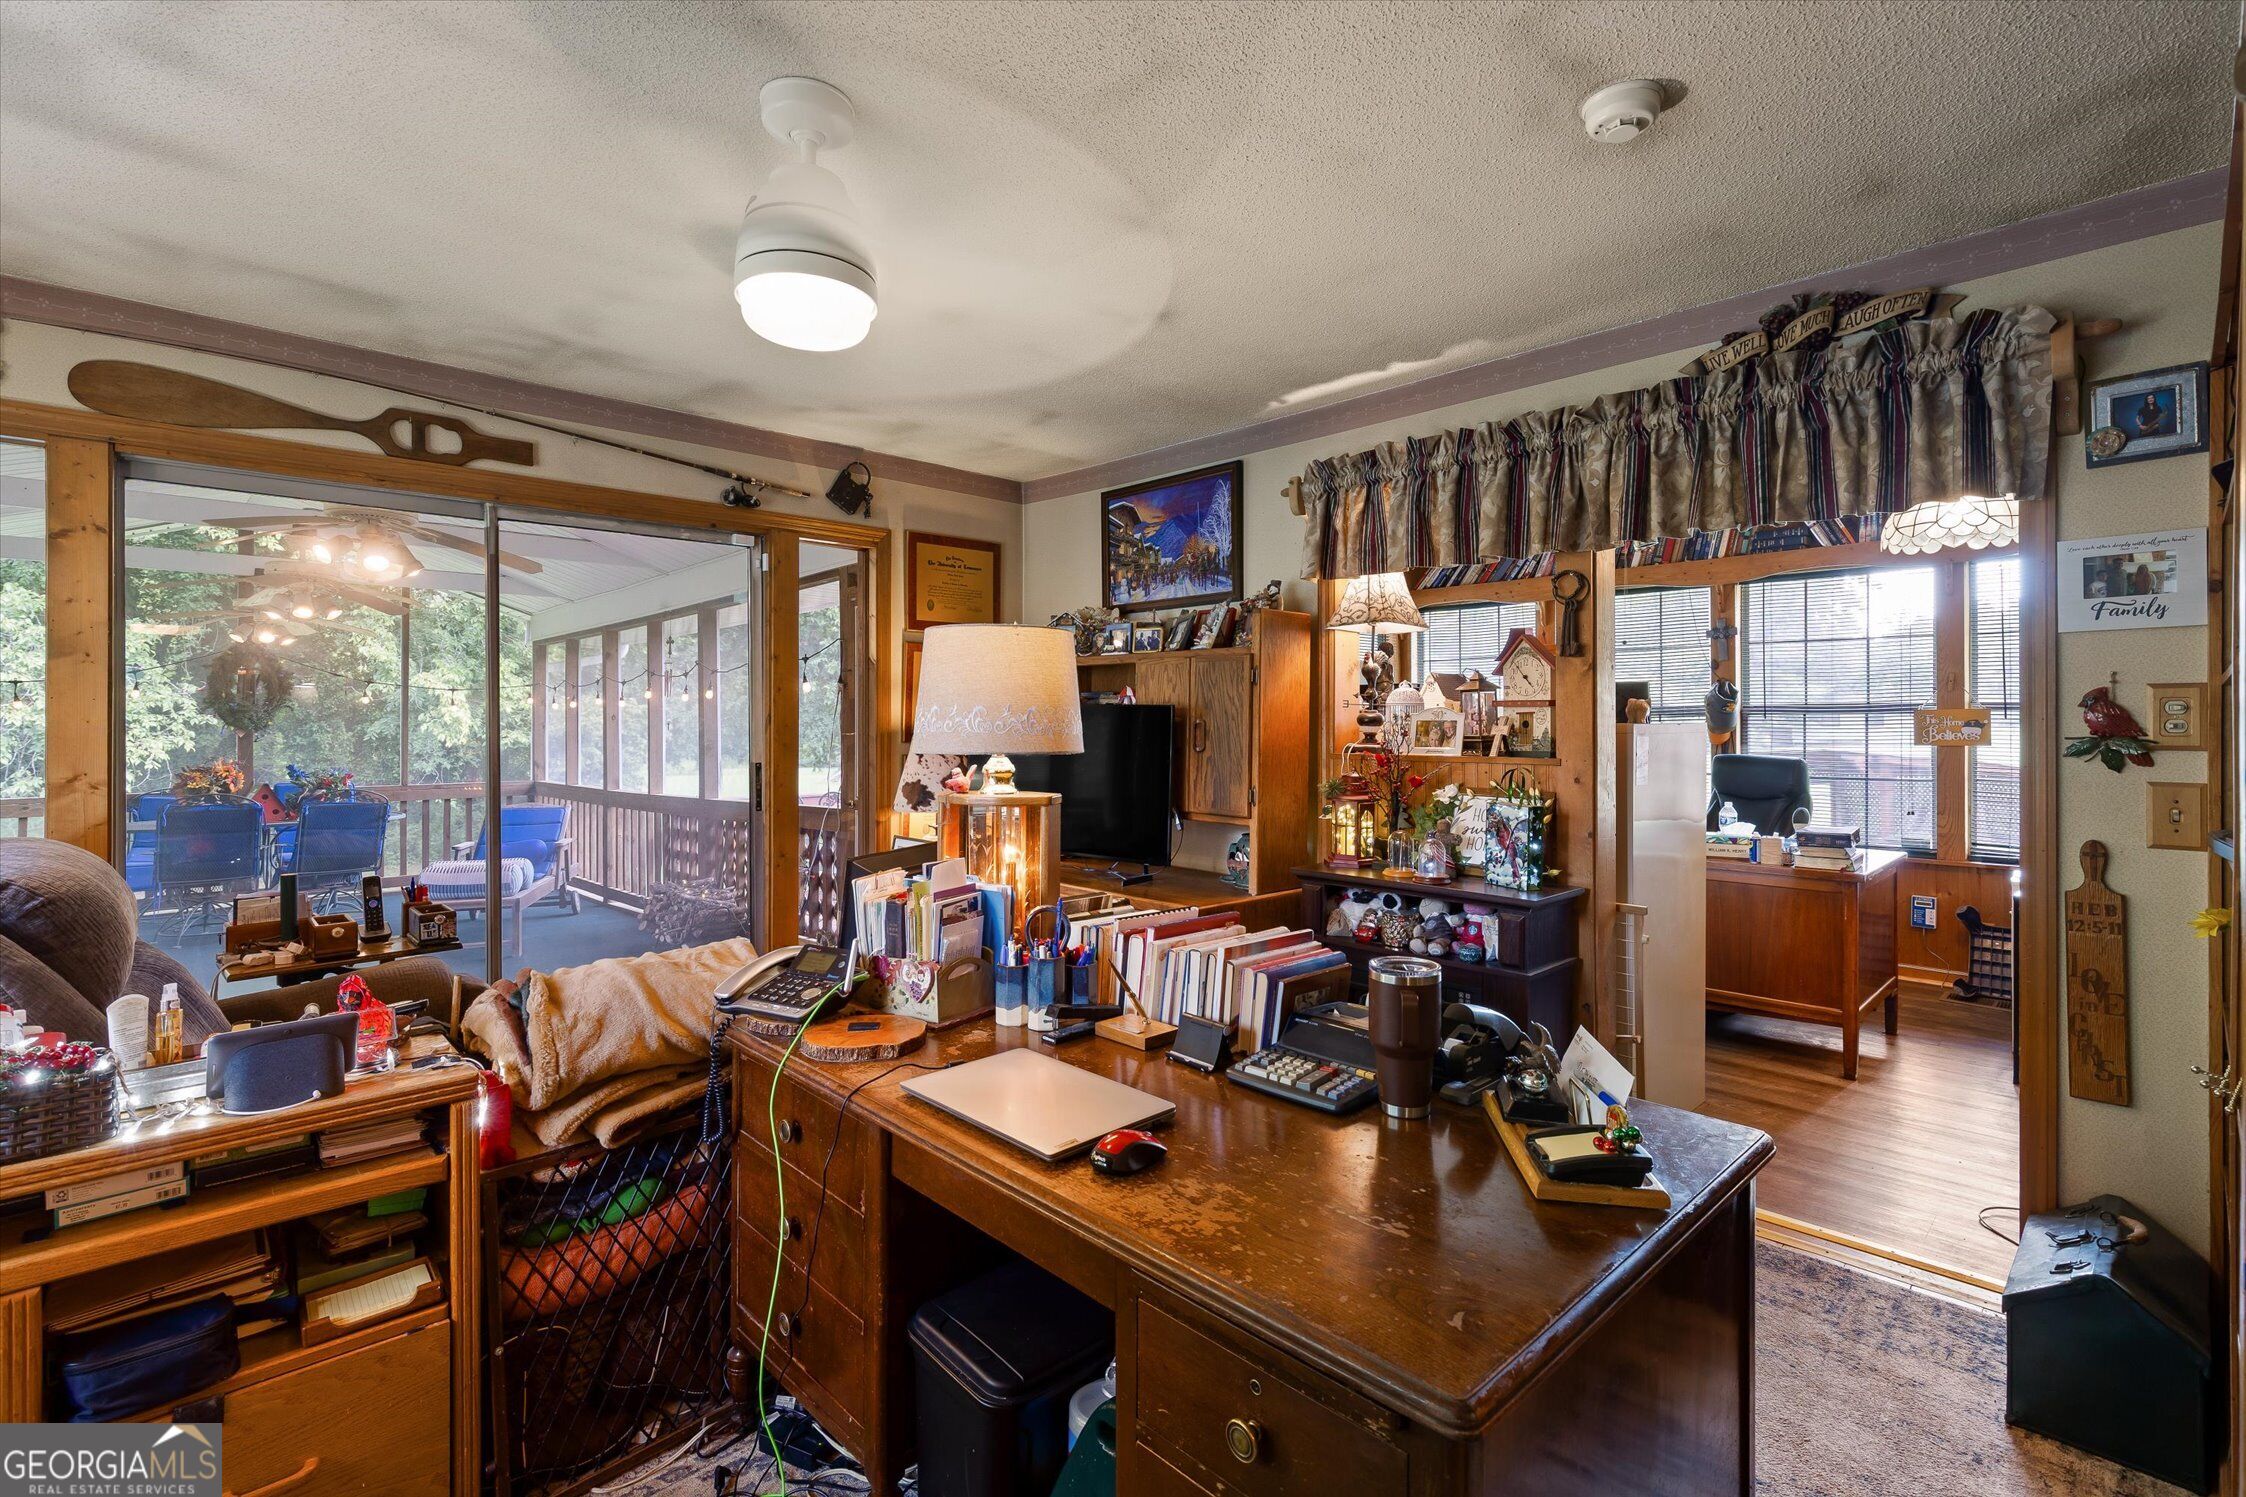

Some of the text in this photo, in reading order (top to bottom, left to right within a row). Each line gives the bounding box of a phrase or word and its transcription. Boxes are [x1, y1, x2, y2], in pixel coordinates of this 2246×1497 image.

[1839, 291, 1929, 331] AUGH OFTEN
[1776, 310, 1831, 350] OVE MUCH
[1703, 334, 1767, 374] LIVE WELL
[2112, 541, 2131, 549] deeply
[2132, 539, 2146, 547] with
[2091, 596, 2169, 620] Family
[1921, 713, 1965, 729] This Home
[1921, 724, 1981, 745] Believes
